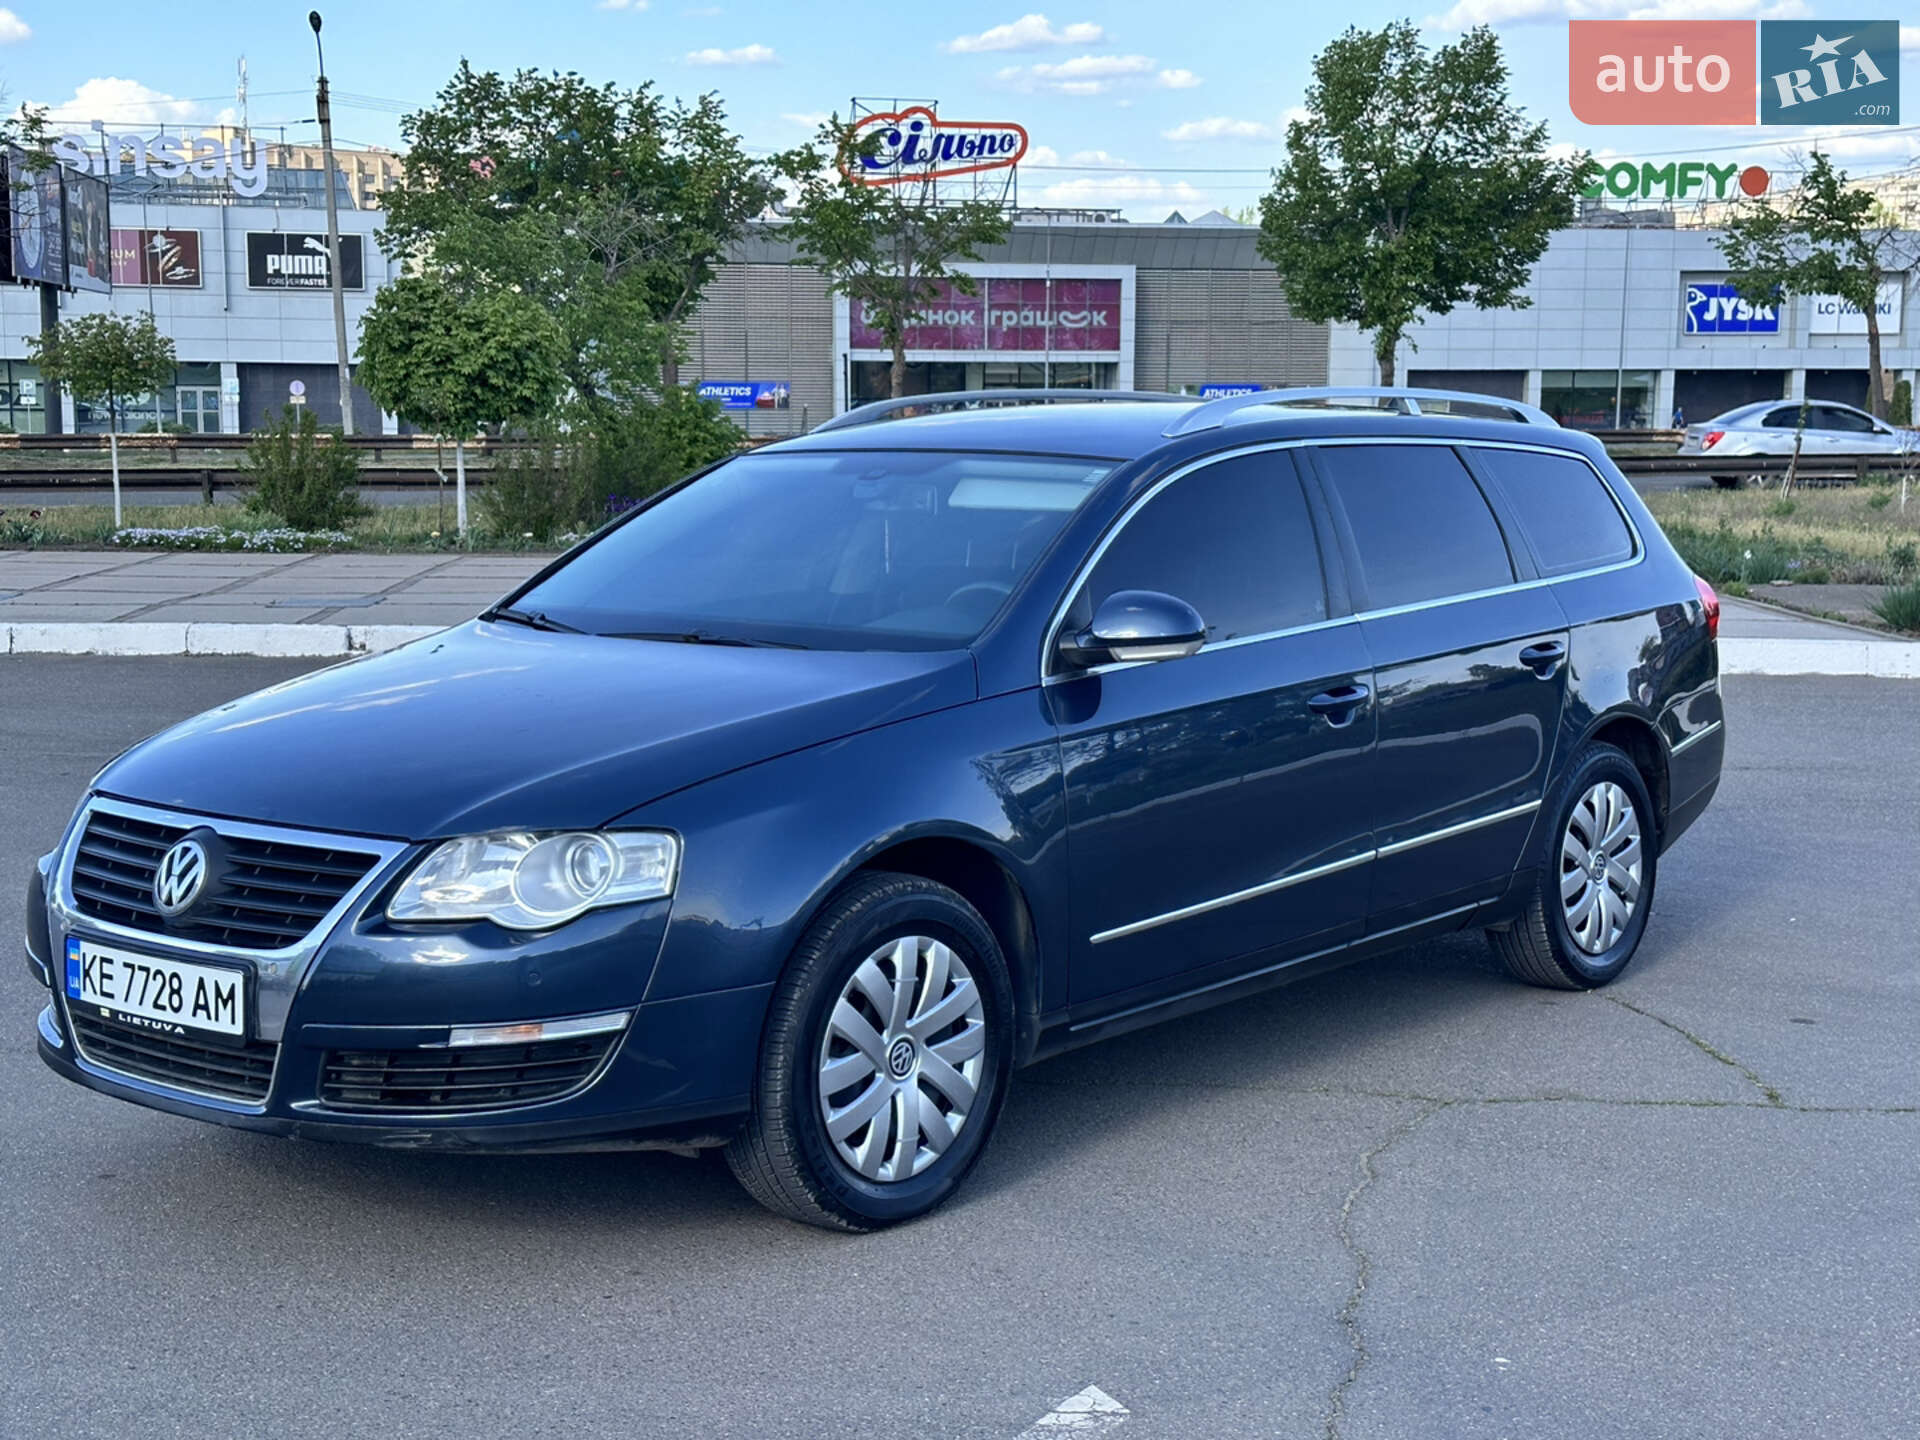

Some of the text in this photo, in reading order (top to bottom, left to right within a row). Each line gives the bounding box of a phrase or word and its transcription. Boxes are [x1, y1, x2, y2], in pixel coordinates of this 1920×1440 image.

[1582, 161, 1738, 199] COMFY
[266, 254, 326, 275] PUMA
[1703, 297, 1776, 321] JYSK
[1818, 303, 1836, 315] LC
[699, 386, 752, 396] ATHLETICS
[82, 952, 115, 1000] KE
[122, 961, 184, 1014] 7728
[191, 975, 236, 1025] AM
[118, 1013, 185, 1034] LIETUVA
